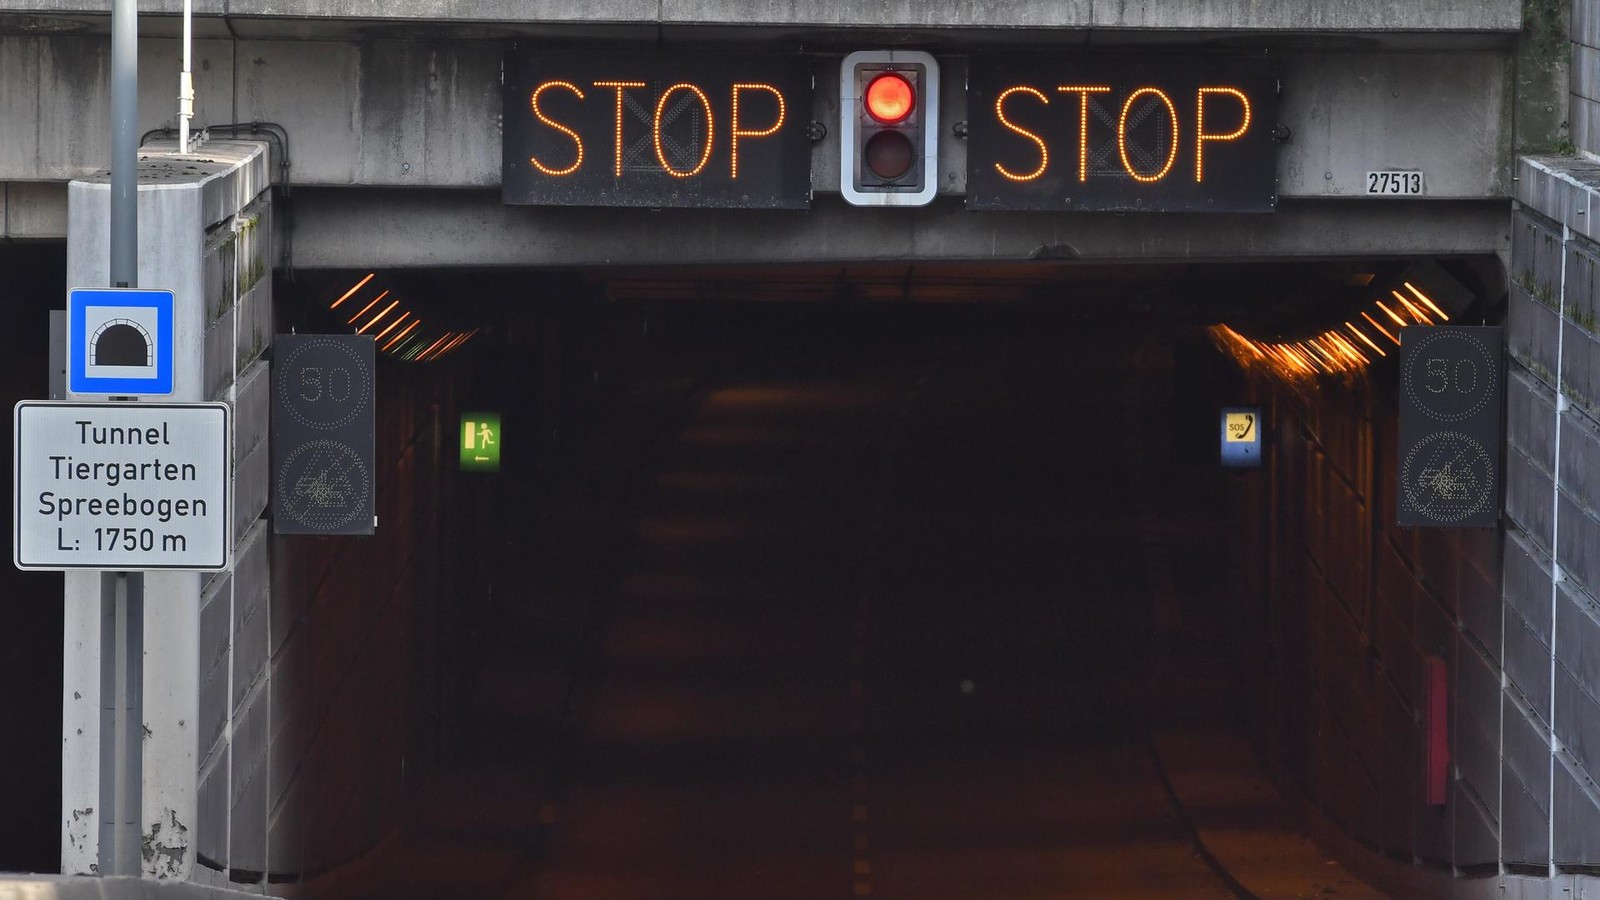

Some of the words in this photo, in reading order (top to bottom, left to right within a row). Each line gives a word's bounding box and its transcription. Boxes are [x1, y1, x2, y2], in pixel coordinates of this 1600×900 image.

[530, 80, 787, 179] STOP
[994, 85, 1253, 183] STOP
[1368, 172, 1421, 194] 27513
[75, 420, 170, 445] Tunnel
[1229, 423, 1245, 431] SOS
[49, 456, 196, 486] Tiergarten
[38, 491, 207, 522] Spreebogen
[57, 528, 80, 551] L:
[94, 527, 154, 552] 1750
[162, 535, 187, 551] m
